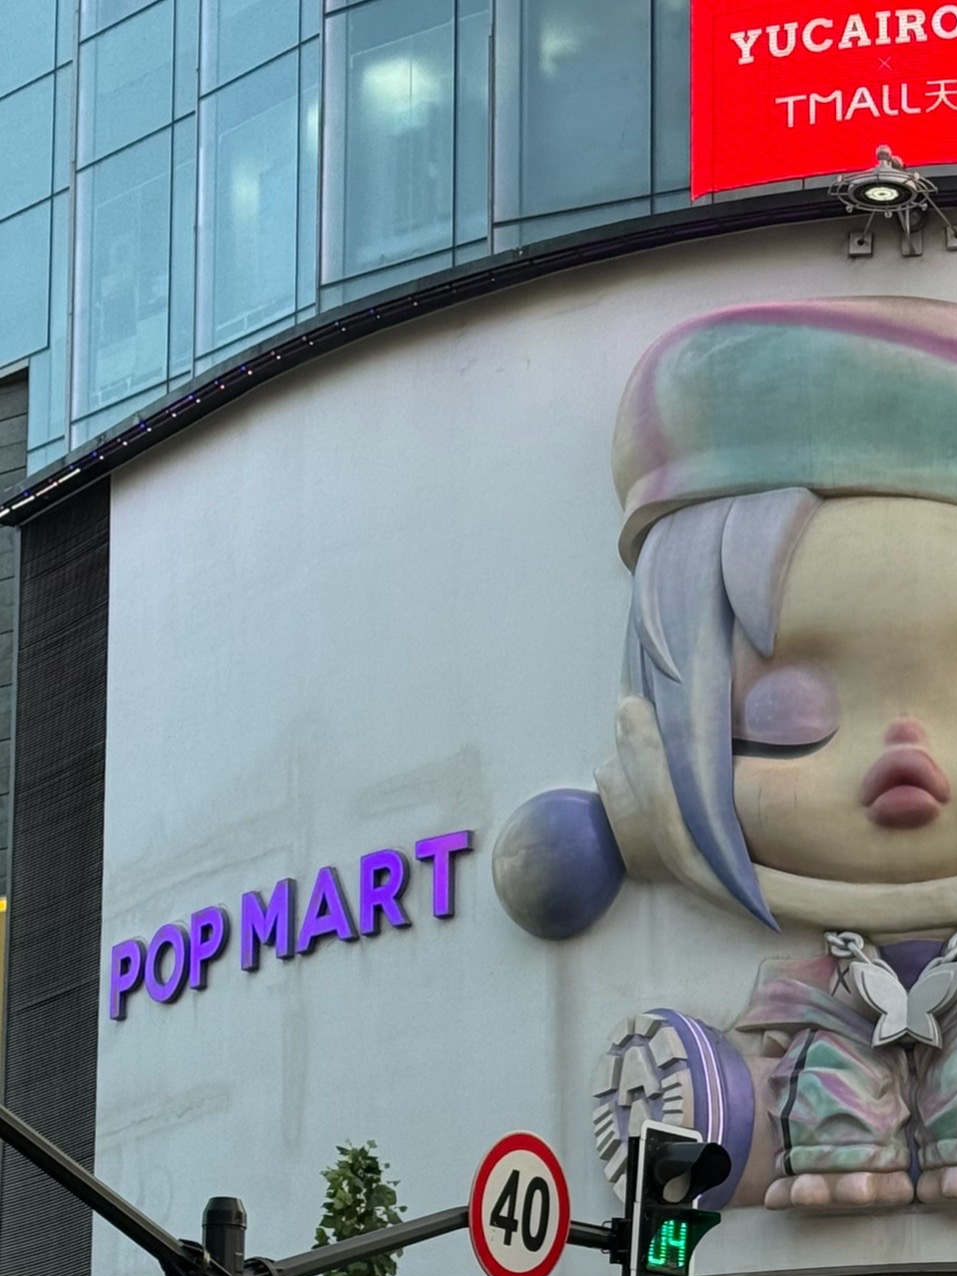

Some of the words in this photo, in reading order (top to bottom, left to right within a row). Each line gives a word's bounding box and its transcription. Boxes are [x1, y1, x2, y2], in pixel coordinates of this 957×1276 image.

[109, 905, 231, 1021] POP
[240, 829, 474, 971] MART
[490, 1169, 550, 1252] 40
